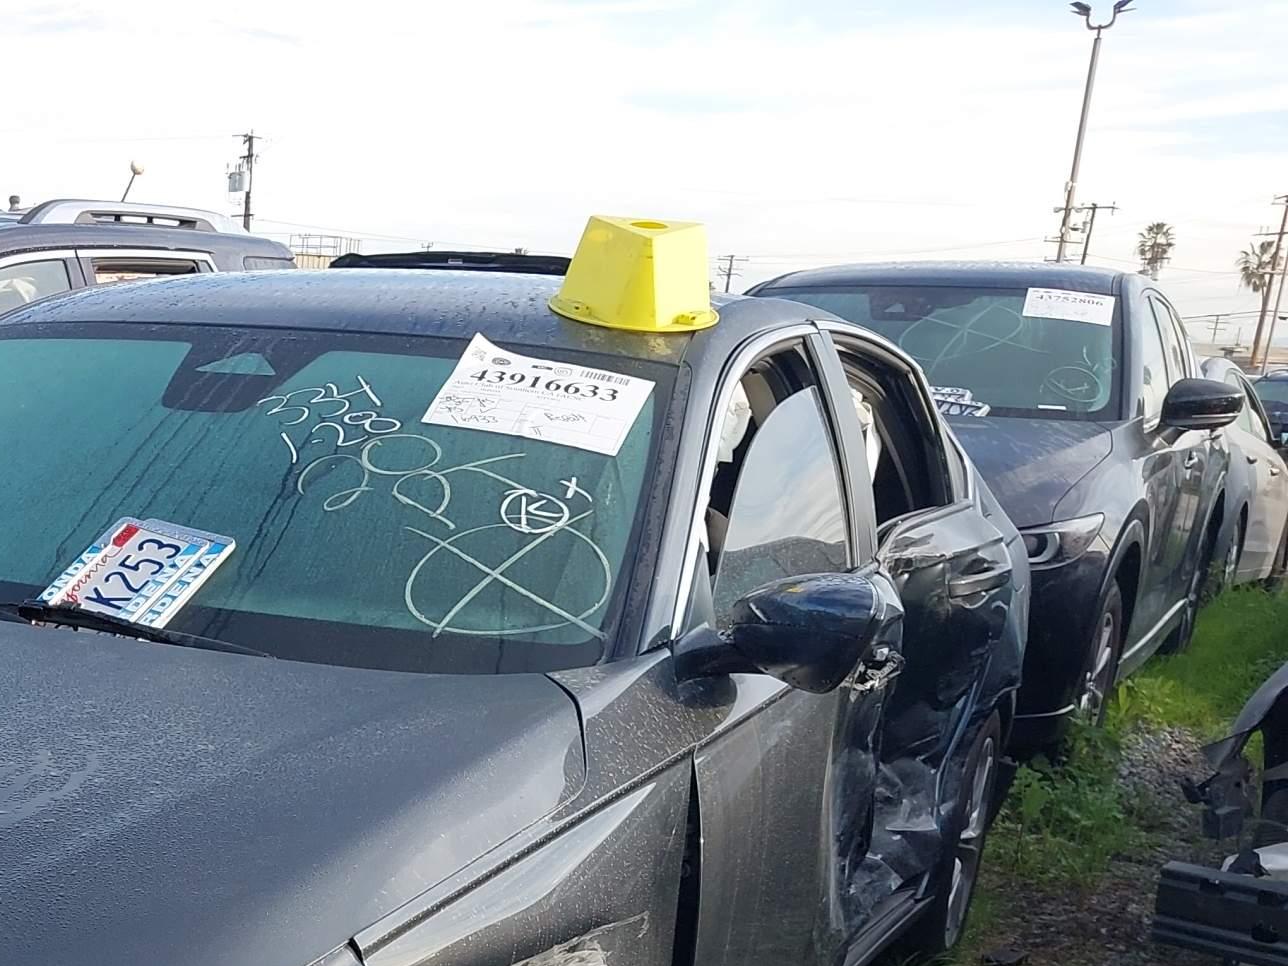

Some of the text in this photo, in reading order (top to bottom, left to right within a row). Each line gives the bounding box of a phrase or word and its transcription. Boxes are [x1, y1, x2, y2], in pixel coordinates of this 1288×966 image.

[470, 368, 620, 402] 43916633
[41, 551, 101, 601] ONDA
[85, 538, 182, 610] K253
